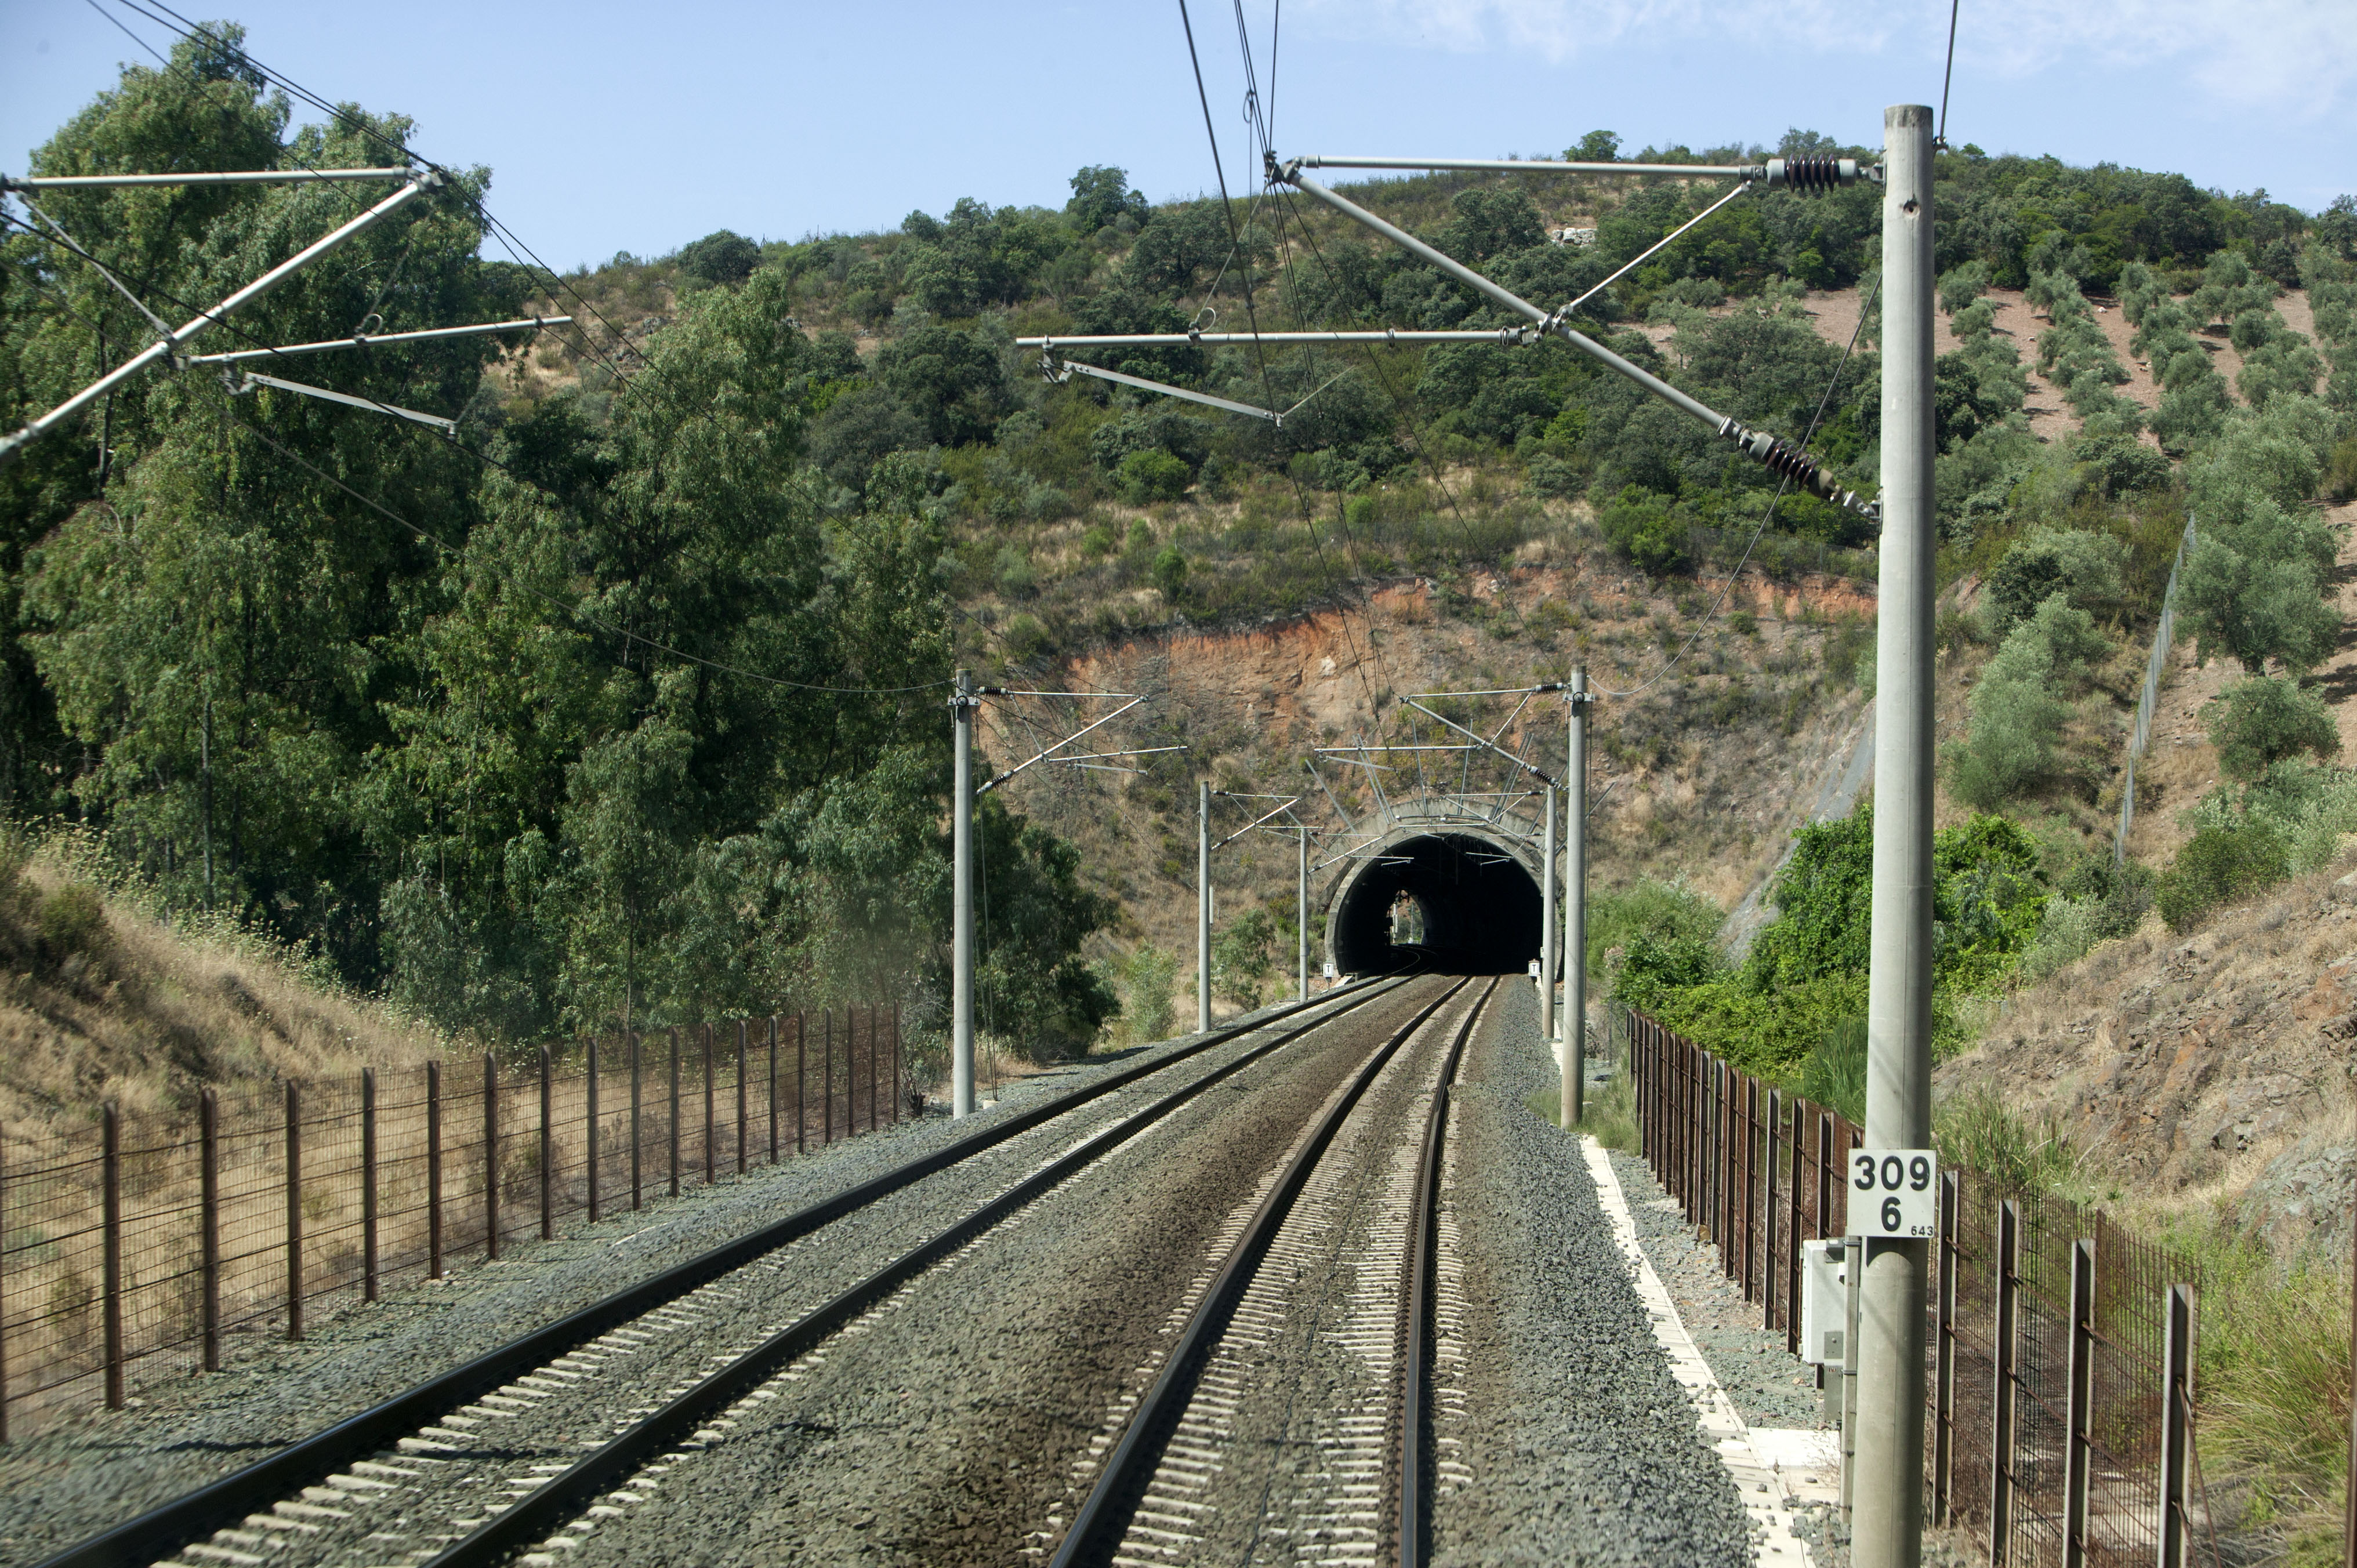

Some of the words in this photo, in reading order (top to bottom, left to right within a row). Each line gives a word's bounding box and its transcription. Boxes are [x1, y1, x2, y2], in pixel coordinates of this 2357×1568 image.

[1326, 965, 1331, 973] T
[1532, 964, 1536, 972] T
[1854, 1155, 1930, 1190] 309
[1881, 1196, 1902, 1232] 6
[1911, 1225, 1934, 1236] 643
